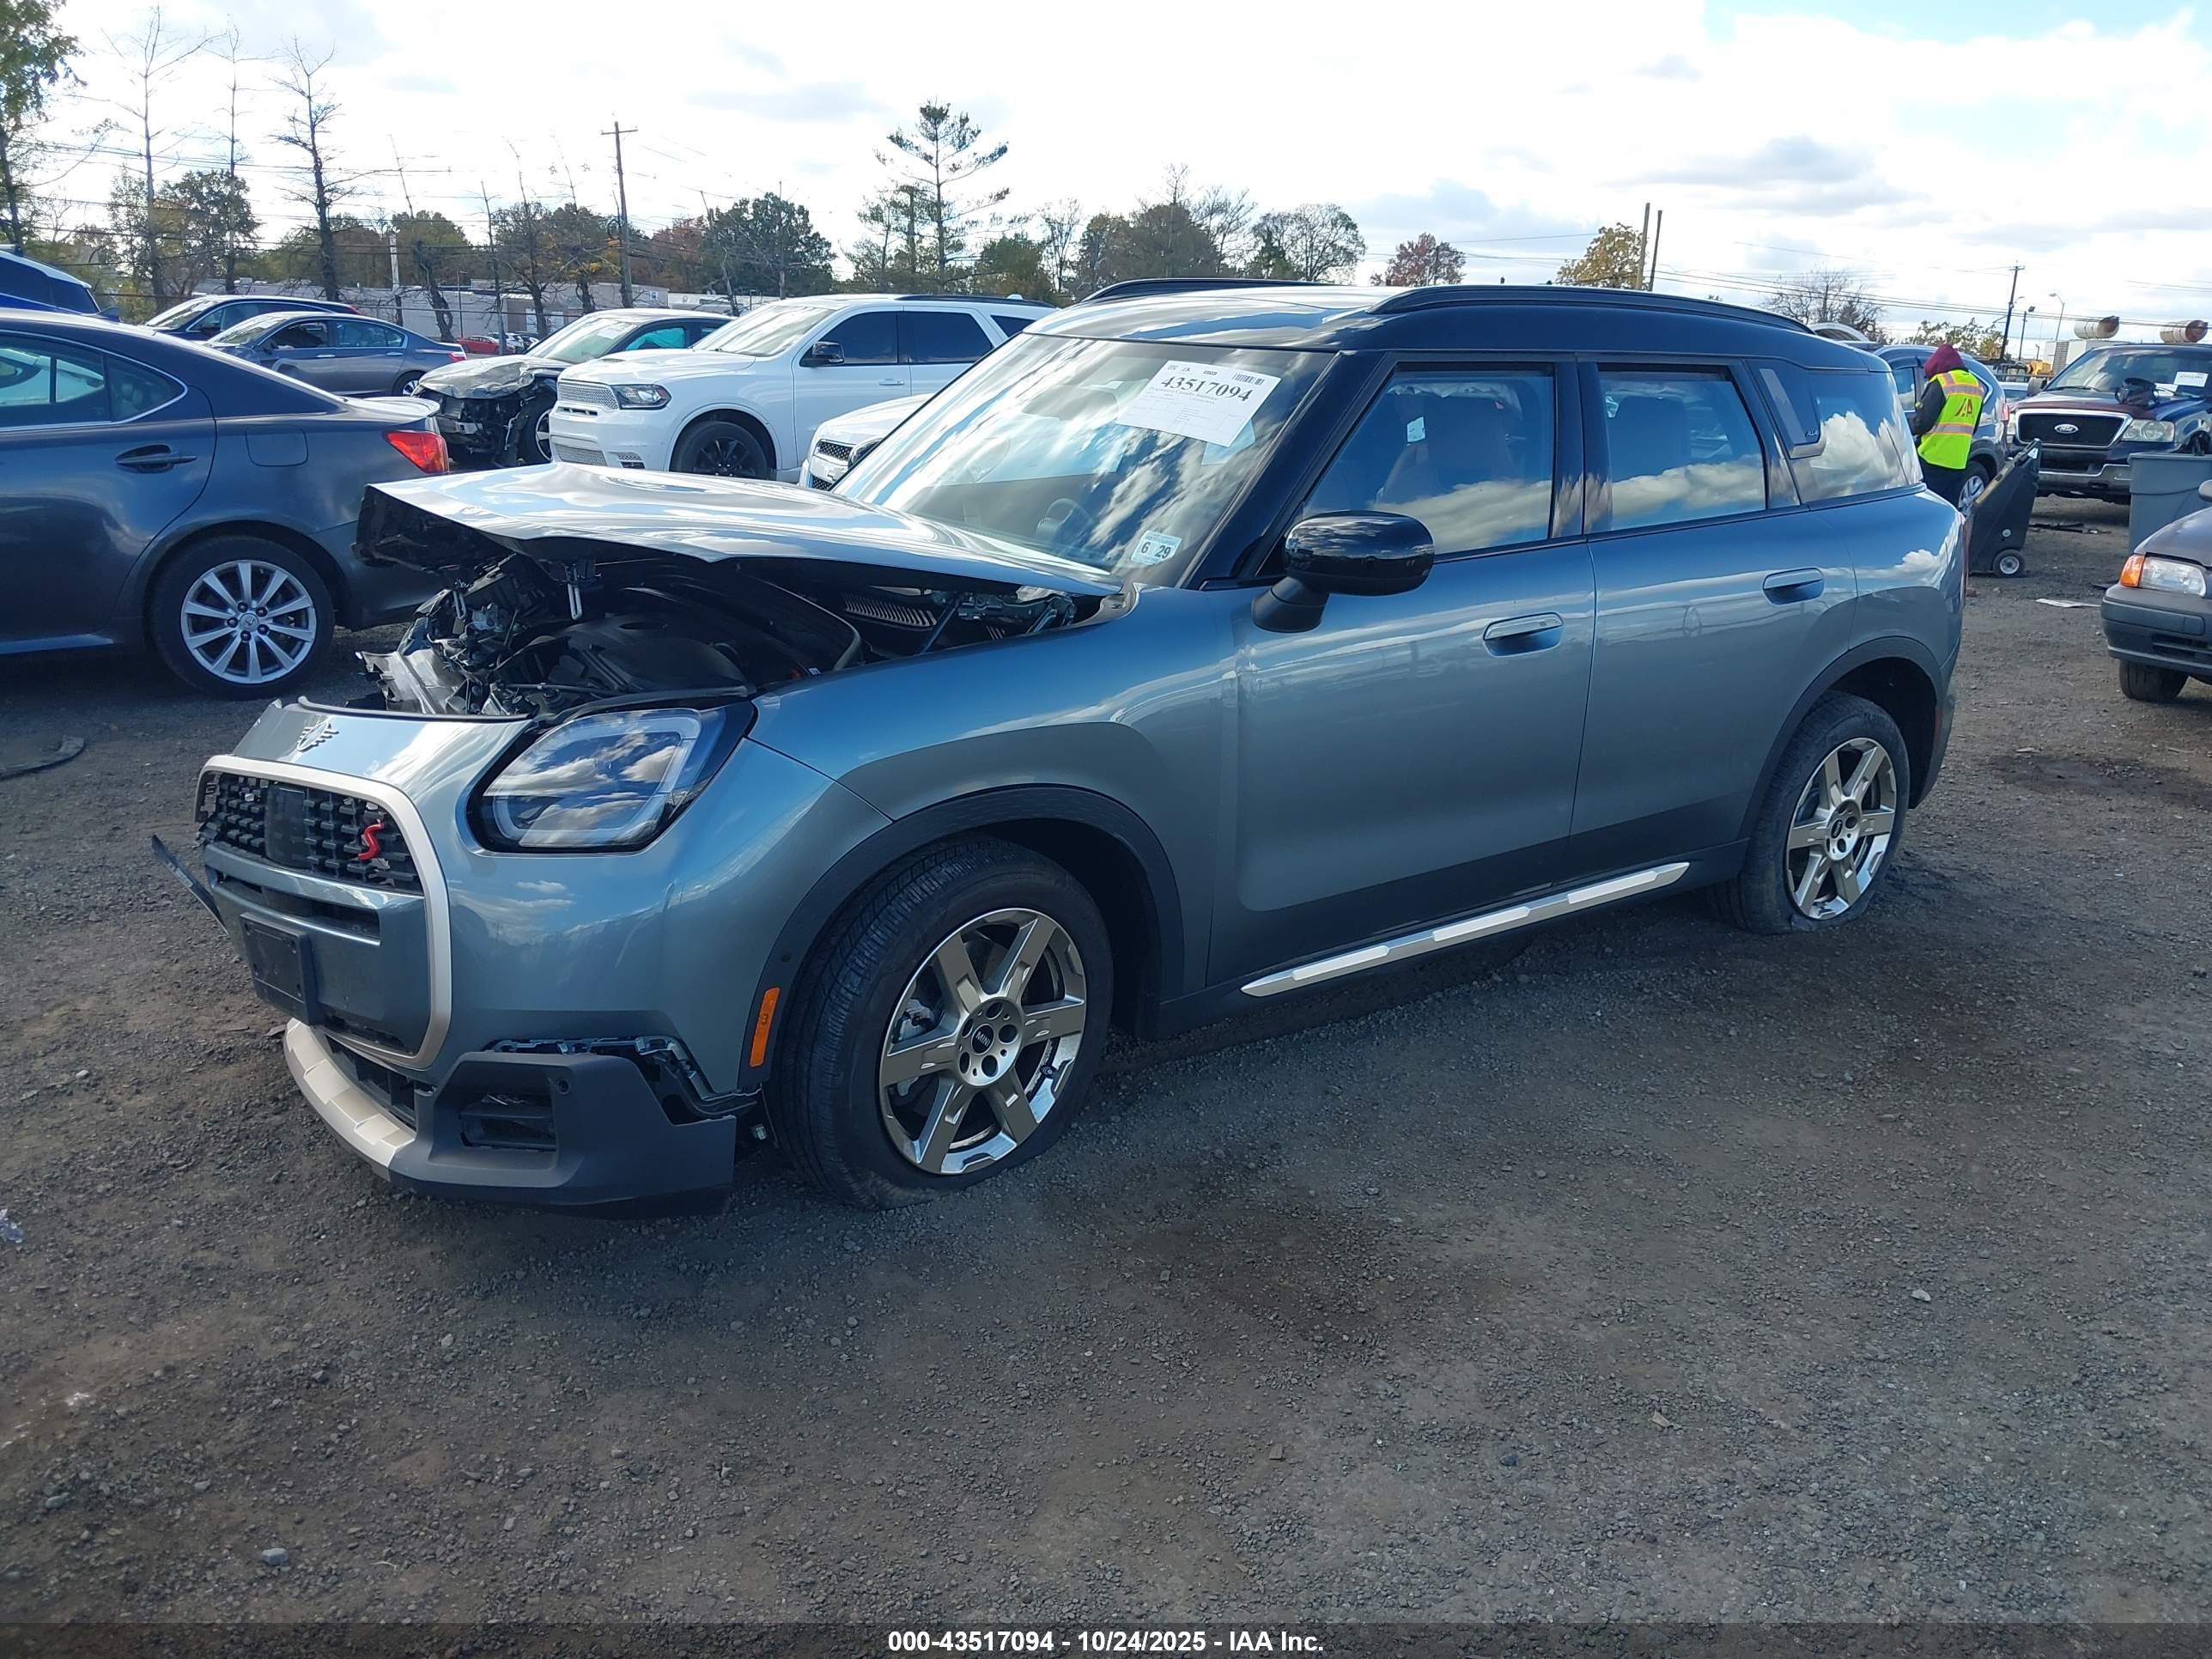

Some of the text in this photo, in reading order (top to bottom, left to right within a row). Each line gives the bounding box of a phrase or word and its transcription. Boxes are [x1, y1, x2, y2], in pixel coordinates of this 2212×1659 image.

[1161, 376, 1254, 402] 43517094
[1140, 542, 1171, 558] 6 29
[357, 823, 385, 860] S
[975, 1030, 991, 1048] MINI
